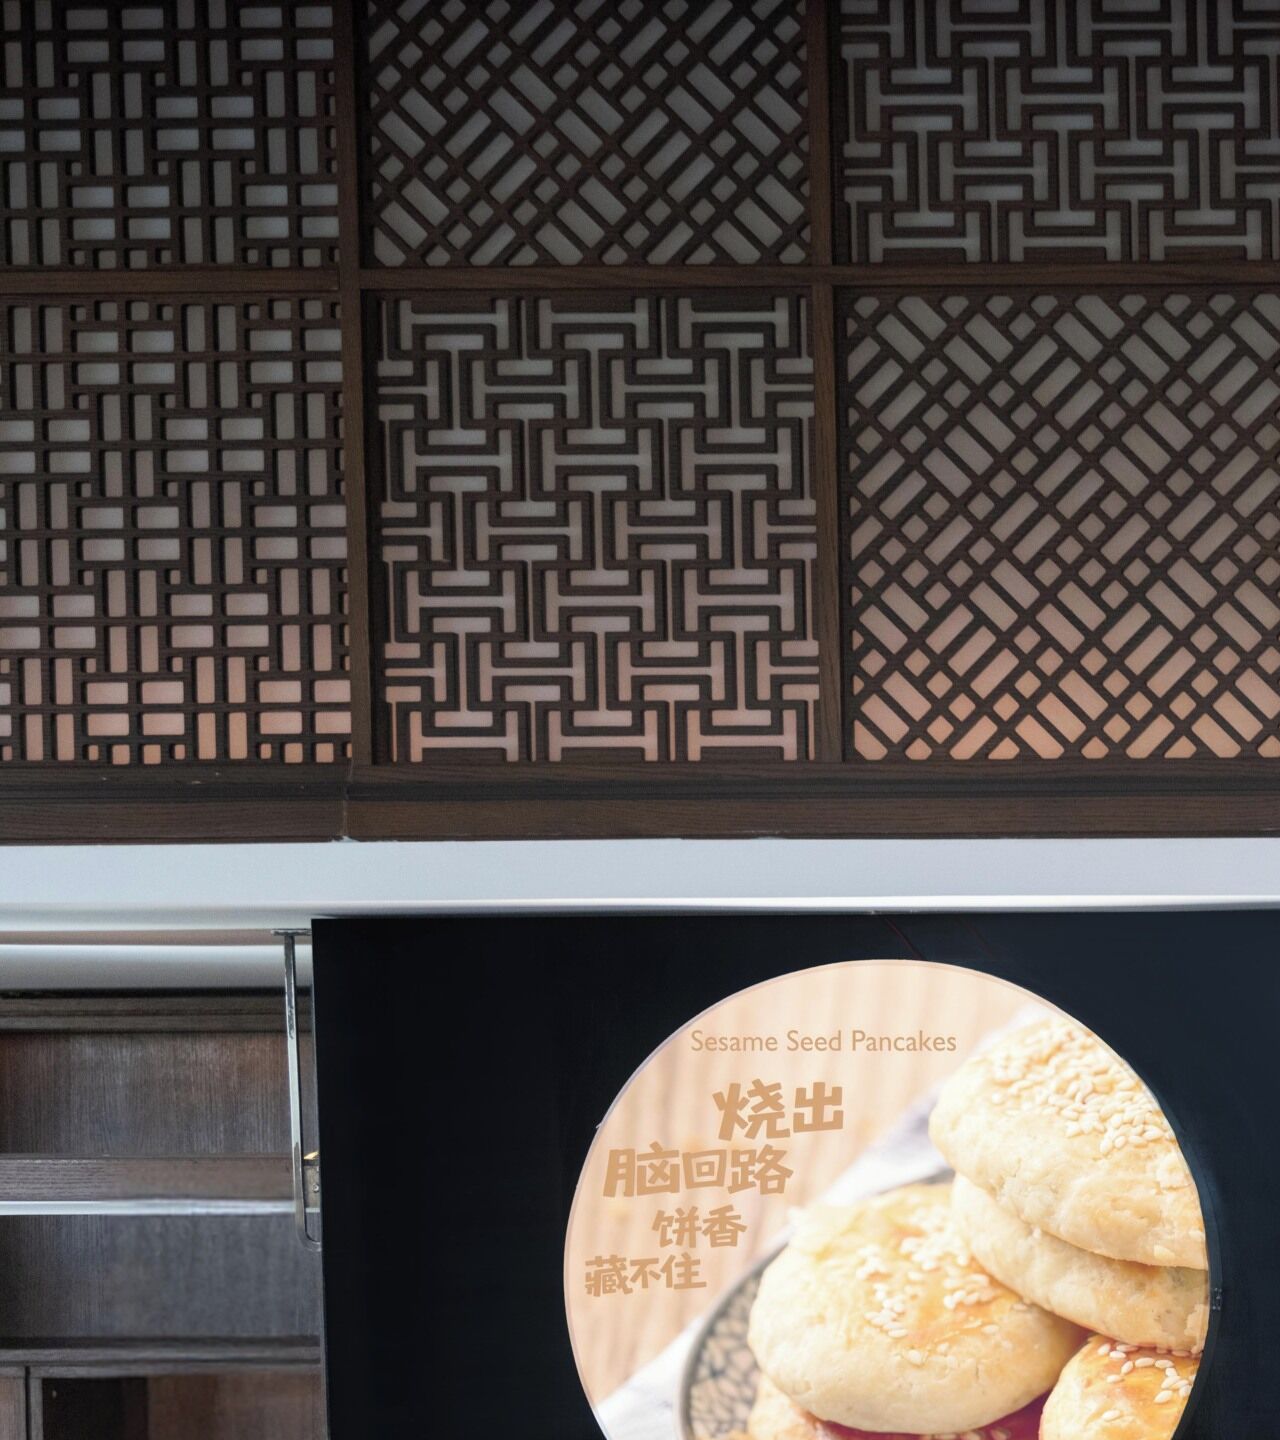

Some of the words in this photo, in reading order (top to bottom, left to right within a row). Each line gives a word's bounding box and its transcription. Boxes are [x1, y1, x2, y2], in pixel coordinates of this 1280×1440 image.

[690, 1030, 778, 1052] Sesame
[786, 1030, 842, 1052] Seed
[851, 1029, 957, 1052] Pancakes
[712, 1079, 845, 1141] 烧出
[603, 1141, 794, 1199] 脑回路
[652, 1204, 748, 1249] 饼香
[585, 1252, 707, 1297] 藏不住
